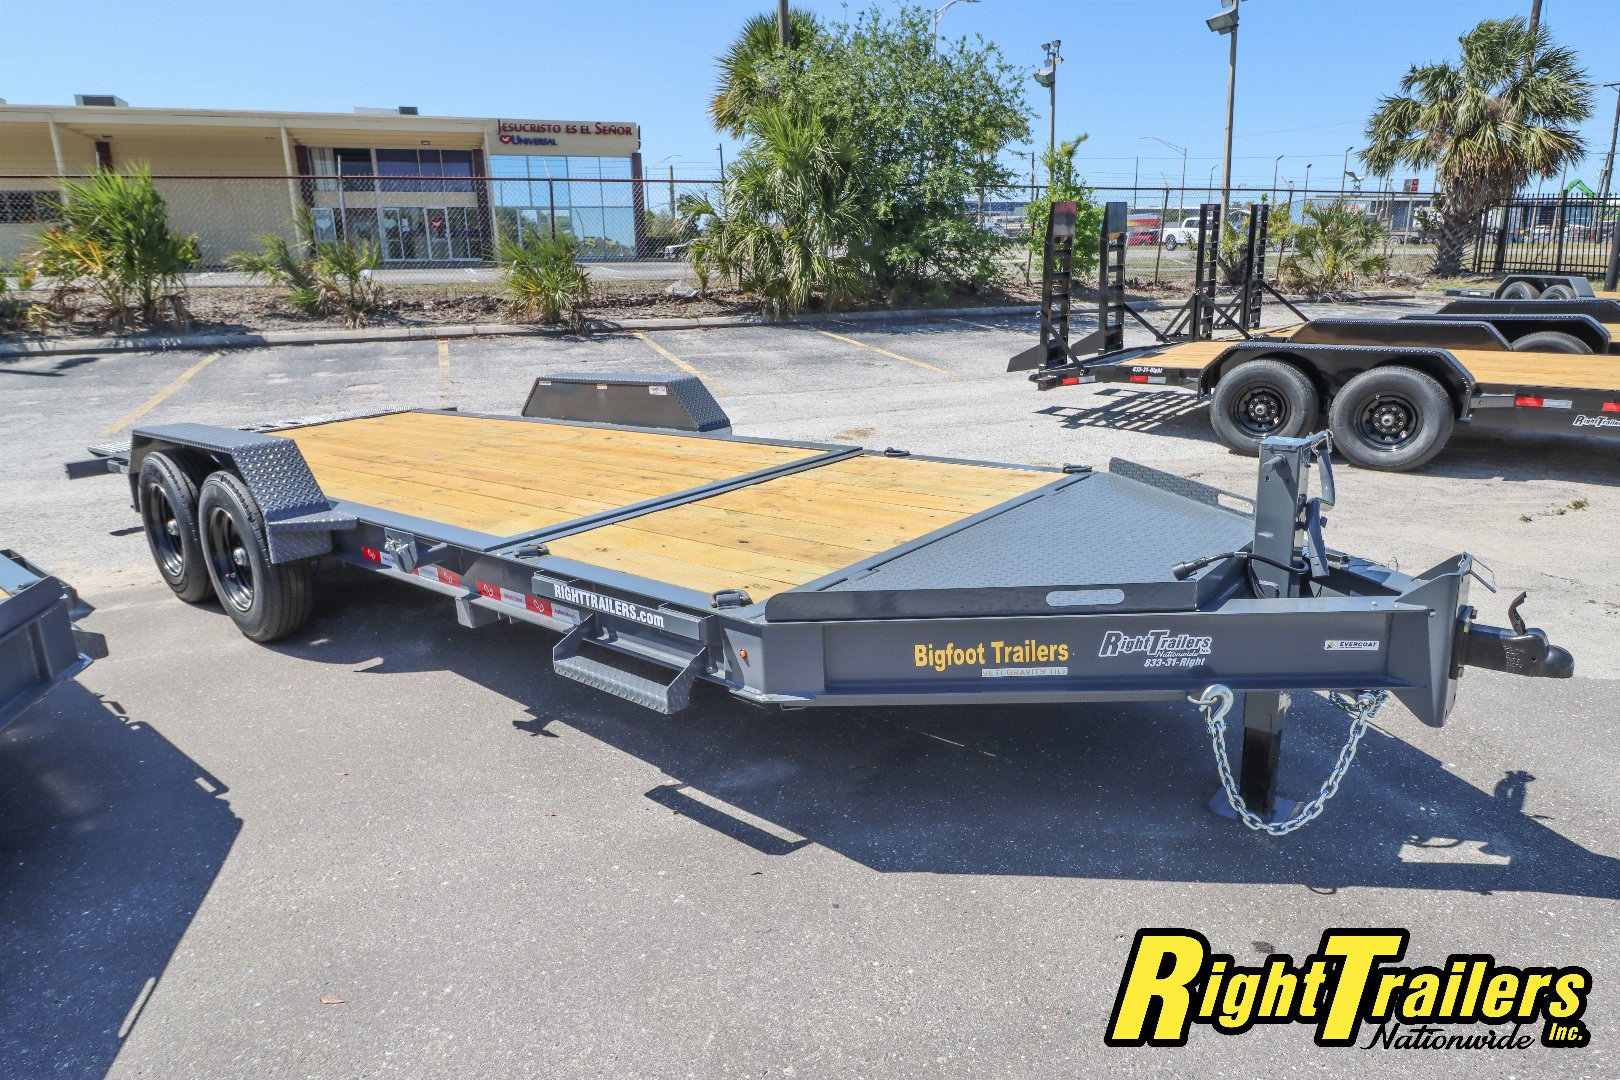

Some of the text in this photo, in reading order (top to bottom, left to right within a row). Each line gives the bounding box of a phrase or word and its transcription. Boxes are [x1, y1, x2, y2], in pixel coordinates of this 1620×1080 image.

[553, 583, 664, 628] RIGHTTRAILERS.com
[914, 639, 1069, 672] Bigfoot Trailers
[1143, 657, 1206, 668] 833-31-Right
[982, 667, 1067, 677] YETI GRAVITY TILT
